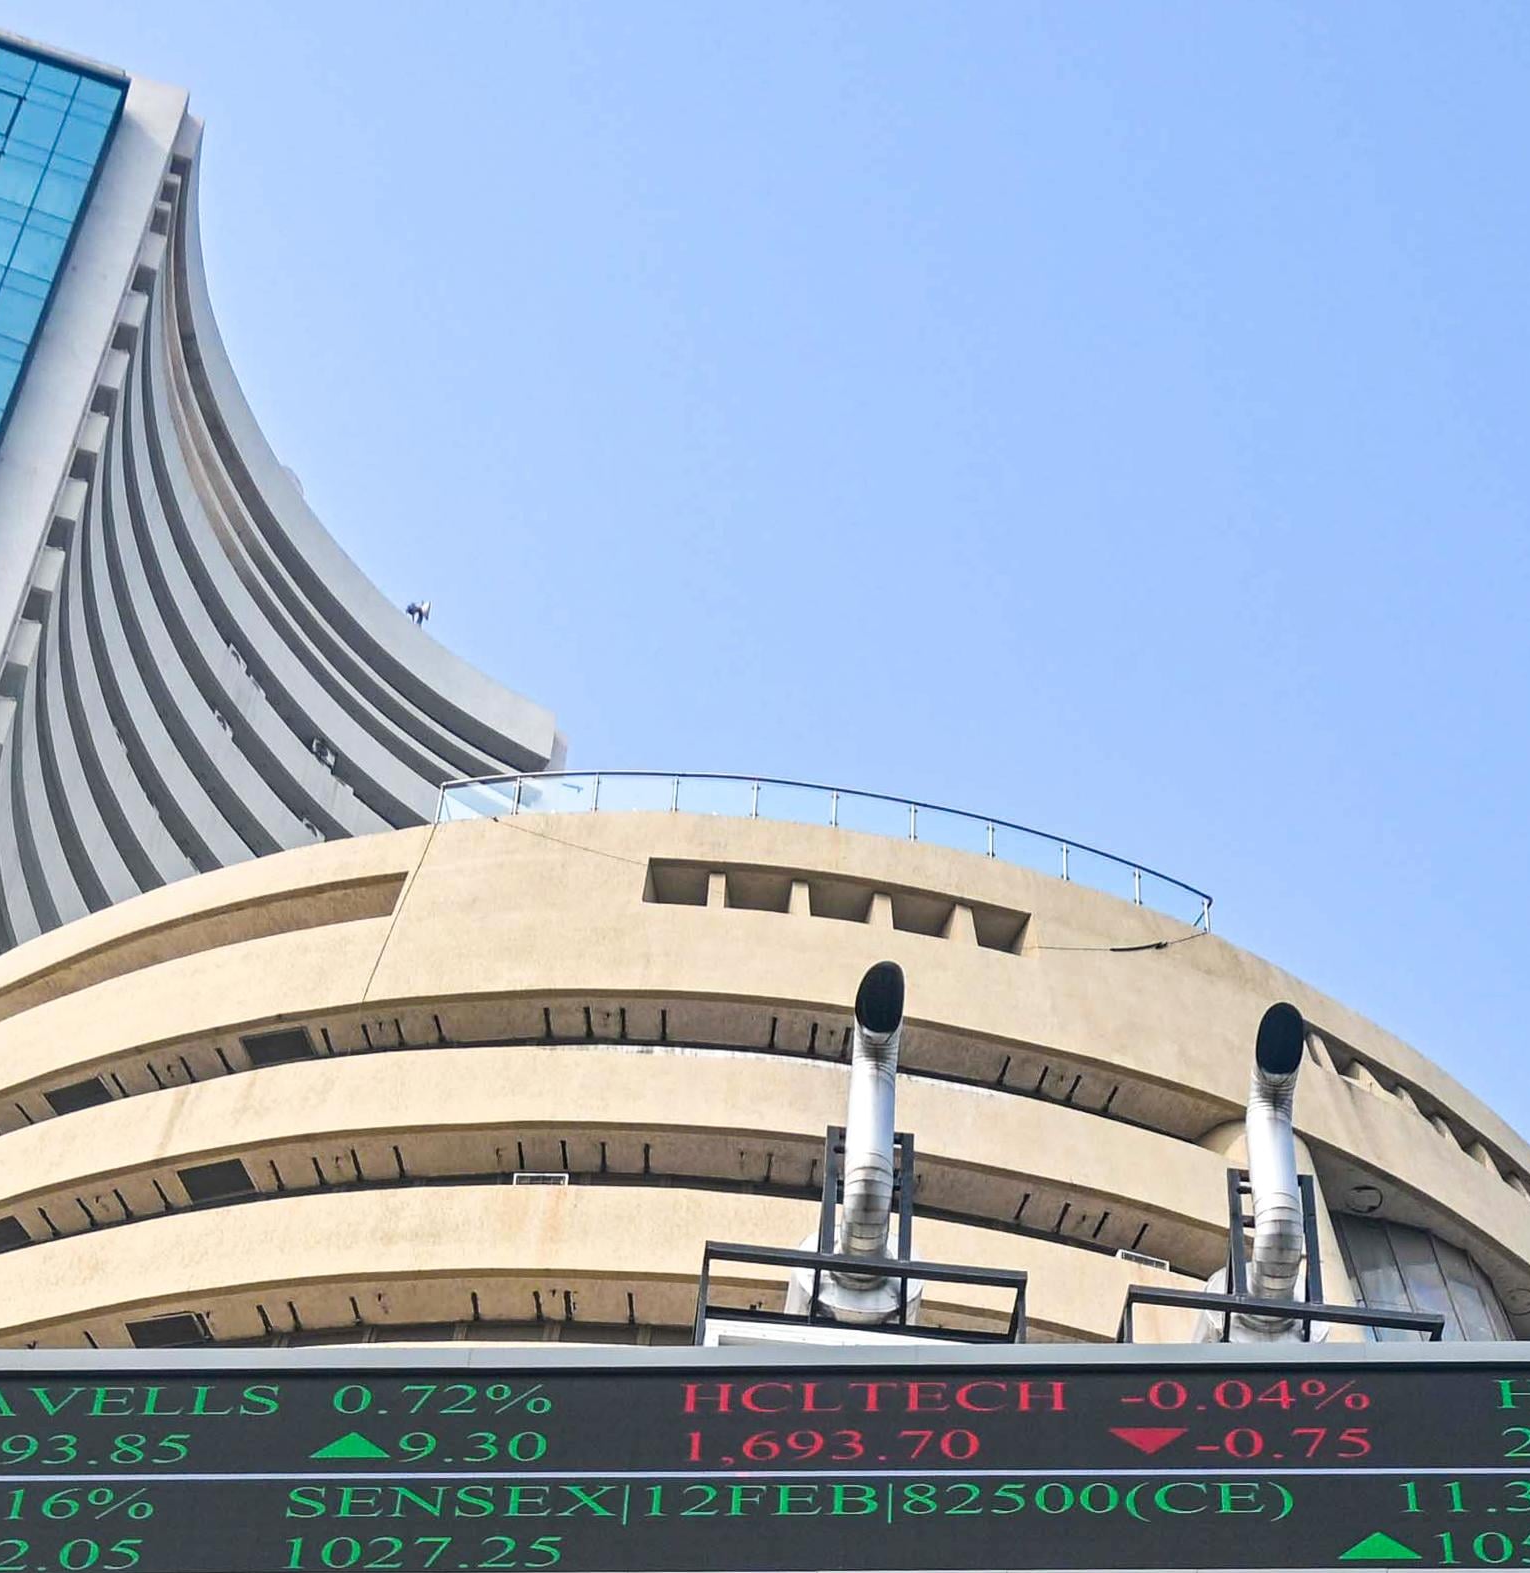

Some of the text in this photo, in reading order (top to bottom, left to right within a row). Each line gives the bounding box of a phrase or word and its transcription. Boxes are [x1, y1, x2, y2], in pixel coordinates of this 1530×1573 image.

[332, 1383, 553, 1416] 0.72%
[680, 1380, 1370, 1413] HCLTECH -0.04%
[397, 1432, 548, 1464] 9.30
[686, 1427, 1372, 1465] 1,693.70 -0.75
[285, 1483, 1294, 1525] SENSEX|12FEB|82500(CE)
[283, 1536, 564, 1569] 1027.25
